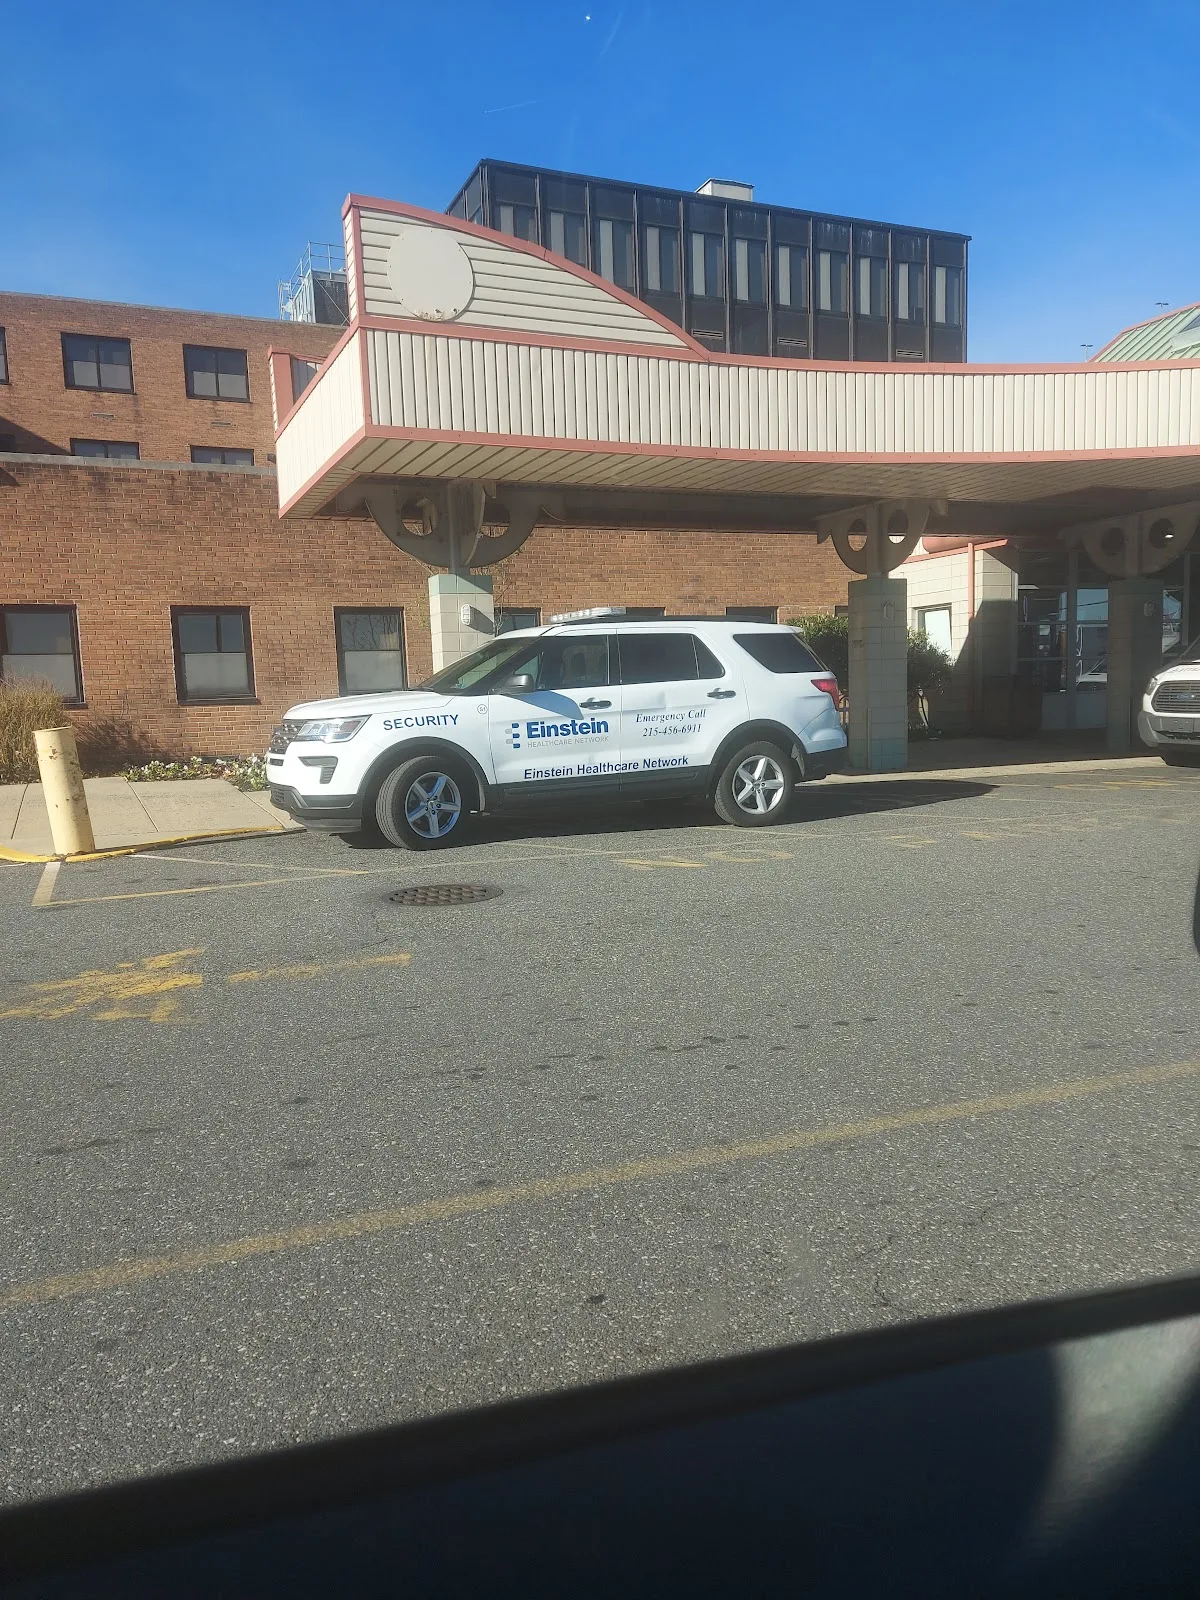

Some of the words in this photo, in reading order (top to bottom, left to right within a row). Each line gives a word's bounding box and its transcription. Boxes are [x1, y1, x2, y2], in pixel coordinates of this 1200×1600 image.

[383, 714, 459, 731] SECURITY
[635, 712, 686, 724] Emergency
[688, 708, 707, 719] Call
[526, 717, 609, 739] Einstein
[642, 723, 702, 737] 215-456-6911
[527, 738, 573, 749] HEALTHCARE
[574, 735, 609, 745] NETWORK
[524, 765, 573, 780] Einstein
[577, 761, 639, 776] Healthcare
[642, 755, 689, 769] Network
